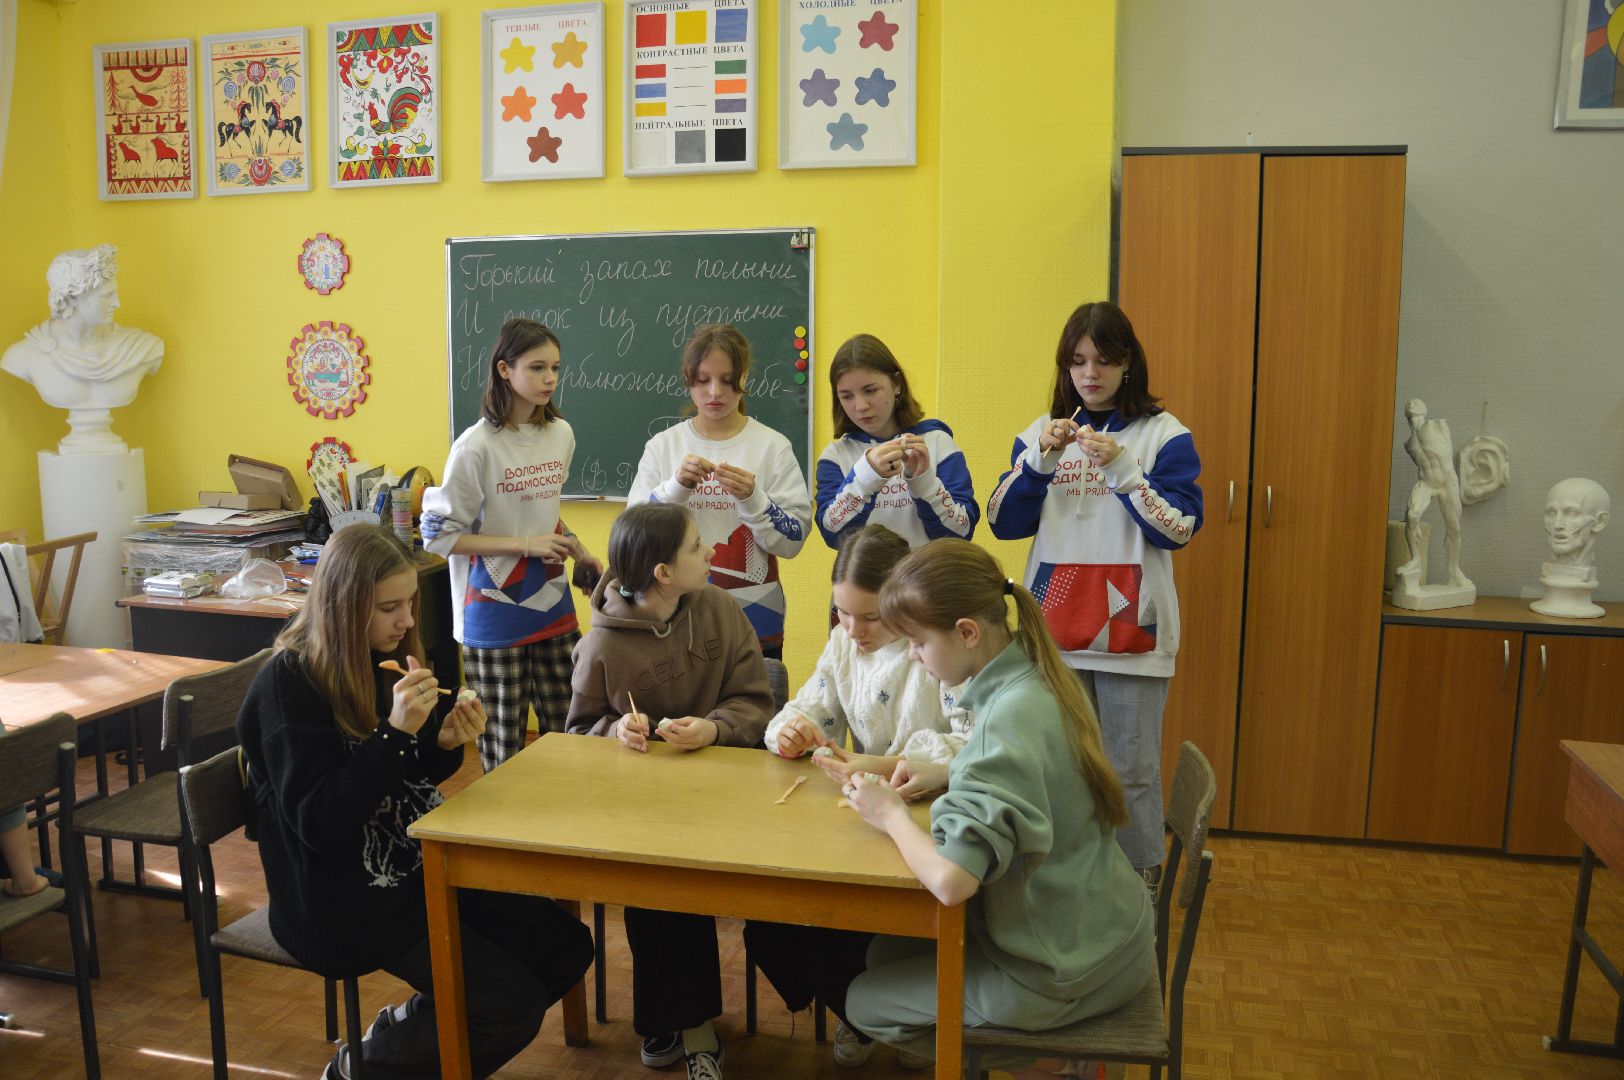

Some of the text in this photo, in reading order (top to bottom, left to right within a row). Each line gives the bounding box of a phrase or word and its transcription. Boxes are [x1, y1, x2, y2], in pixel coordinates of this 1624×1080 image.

[636, 0, 746, 13] ОСНОВНЫЕ ЦВЕТА
[558, 19, 588, 29] ЦВЕТА
[636, 45, 744, 59] КОНТРАСТНЫЕ ЦВЕТА
[635, 118, 743, 130] НЕЙТРАЛЬНЫЕ ЦВЕТА
[460, 253, 797, 305] Горький запах полыни
[600, 304, 637, 358] из
[656, 303, 786, 348] пустыни
[688, 501, 736, 511] МЫ РЯДОМ
[637, 638, 721, 691] CELNE
